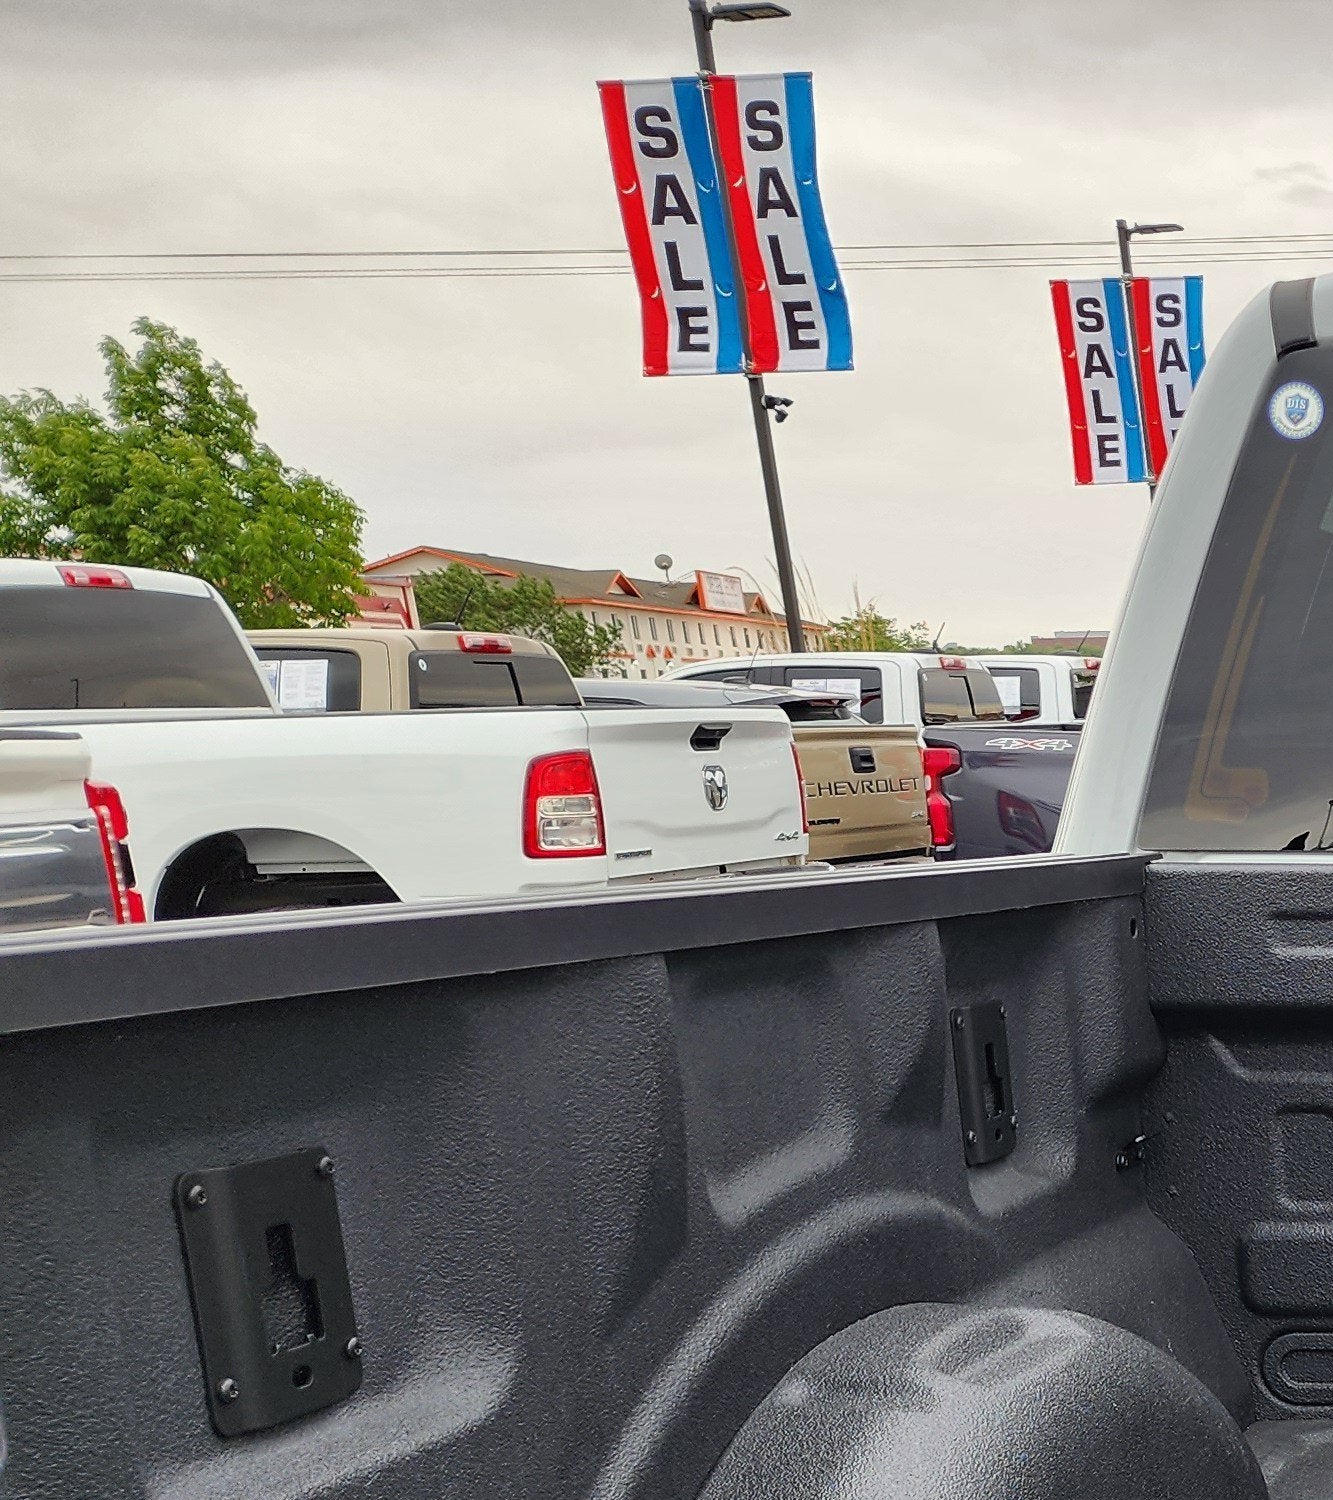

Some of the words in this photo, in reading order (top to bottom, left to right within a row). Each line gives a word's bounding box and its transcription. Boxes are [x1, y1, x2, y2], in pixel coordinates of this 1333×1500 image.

[634, 105, 710, 352] SALE
[744, 99, 820, 351] SALE
[1076, 296, 1121, 467] SALE
[1155, 293, 1188, 442] SAL
[805, 777, 920, 798] CHEVROLET
